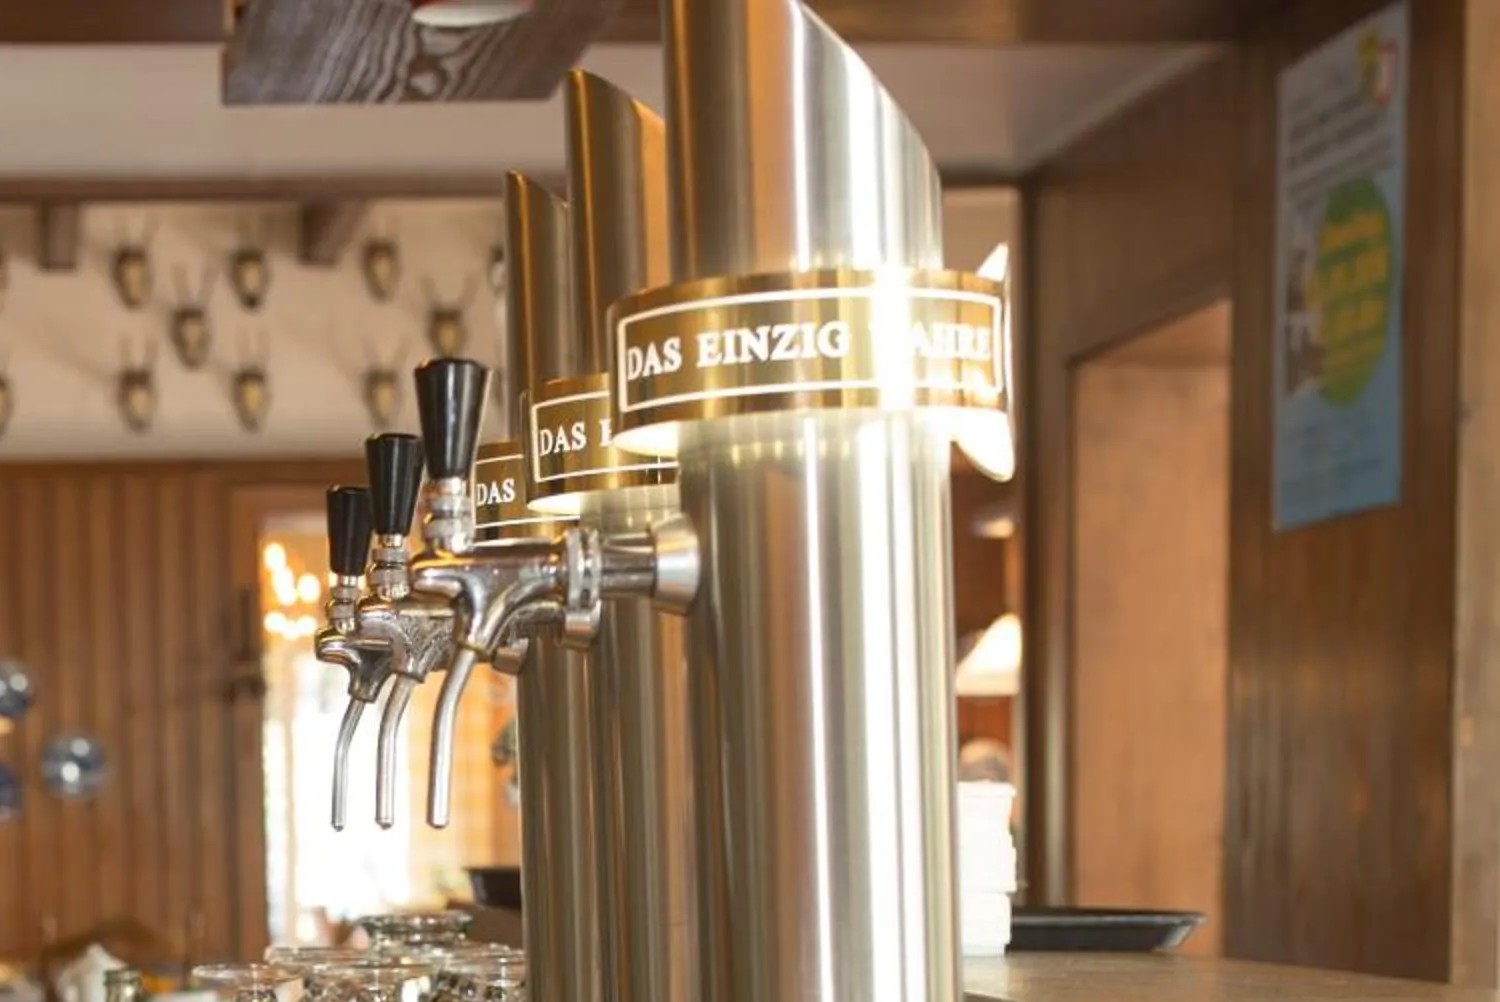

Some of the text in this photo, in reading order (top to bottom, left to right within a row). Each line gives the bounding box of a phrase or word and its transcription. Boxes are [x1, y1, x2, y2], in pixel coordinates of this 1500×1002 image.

[627, 336, 683, 381] DAS
[695, 320, 850, 368] EINZIG
[539, 421, 587, 457] DAS
[476, 478, 516, 507] DAS
